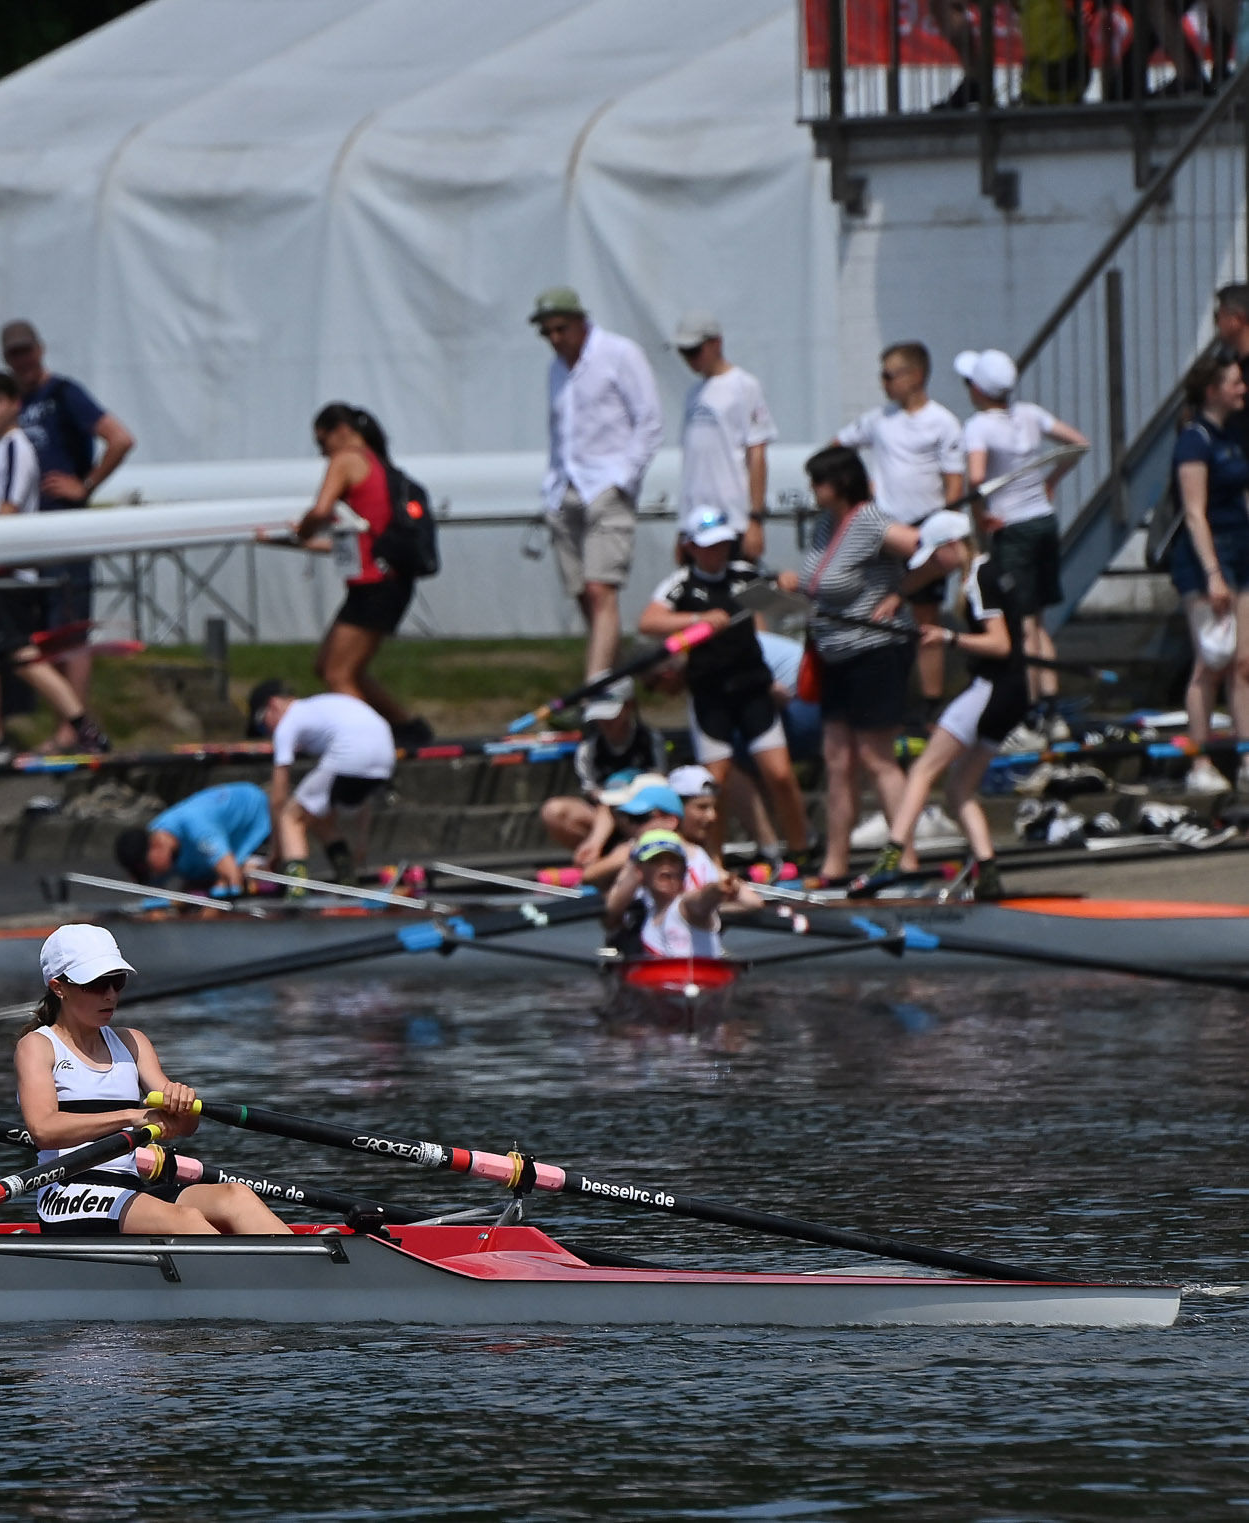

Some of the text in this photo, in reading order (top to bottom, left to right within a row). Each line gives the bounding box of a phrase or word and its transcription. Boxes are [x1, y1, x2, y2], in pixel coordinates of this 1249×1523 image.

[351, 1136, 422, 1160] CROKER
[24, 1166, 66, 1192] CROKER
[581, 1176, 676, 1207] besselrc.de
[40, 1186, 116, 1216] Minden
